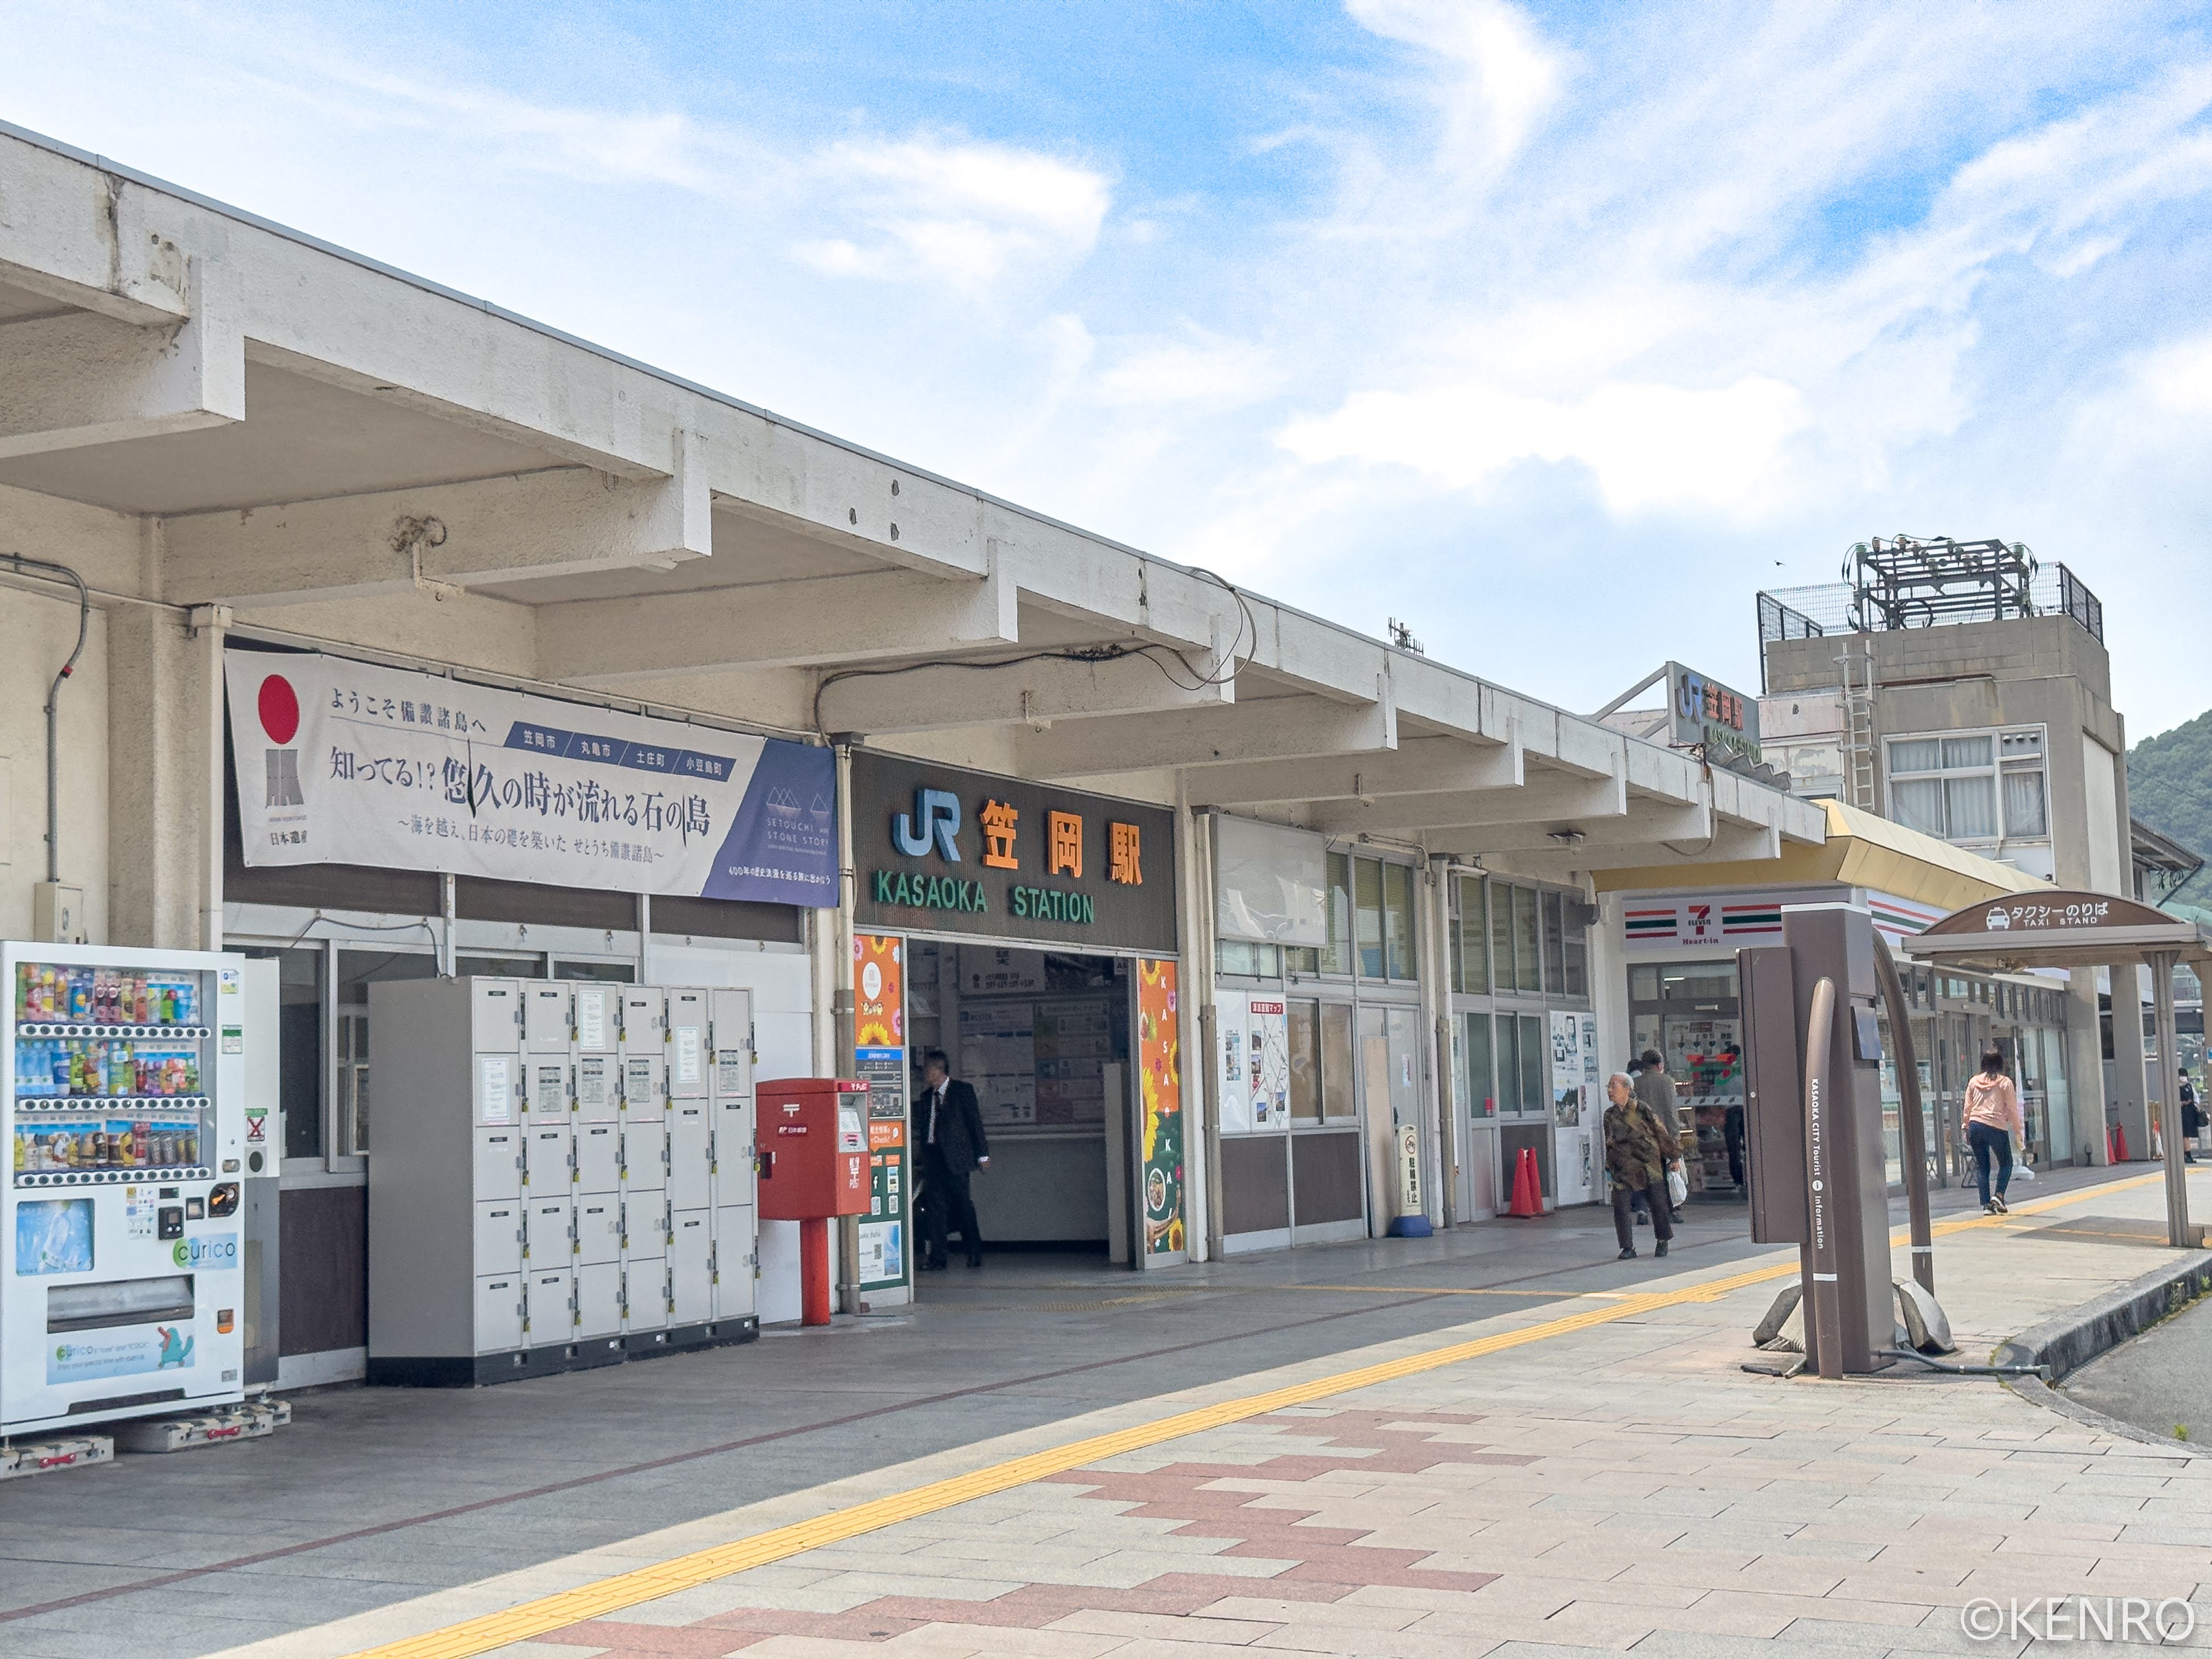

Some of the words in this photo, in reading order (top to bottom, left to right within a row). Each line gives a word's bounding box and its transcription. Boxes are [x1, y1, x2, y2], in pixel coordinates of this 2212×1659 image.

[1675, 673, 1702, 724] JR
[523, 729, 556, 749] 笠岡市
[581, 741, 611, 758] 丸亀市
[637, 751, 665, 767] 土庄町
[686, 757, 723, 775] 小豆島町
[767, 817, 814, 832] SETOUCHI
[767, 831, 798, 843] STONE
[893, 788, 961, 862] JR
[979, 798, 1143, 886] 笠岡駅
[876, 868, 988, 913] KASAOKA
[1012, 885, 1095, 924] STATION
[2011, 901, 2109, 920] タクシーのりば
[2023, 918, 2050, 927] TAXI
[2059, 916, 2098, 926] STAND
[1810, 1078, 1820, 1121] KASAOKA
[1811, 1121, 1820, 1143] CITY
[1812, 1144, 1821, 1176] Tourist
[1408, 1157, 1418, 1203] 駐輪禁止
[1814, 1194, 1824, 1250] Information
[179, 1240, 235, 1261] curico
